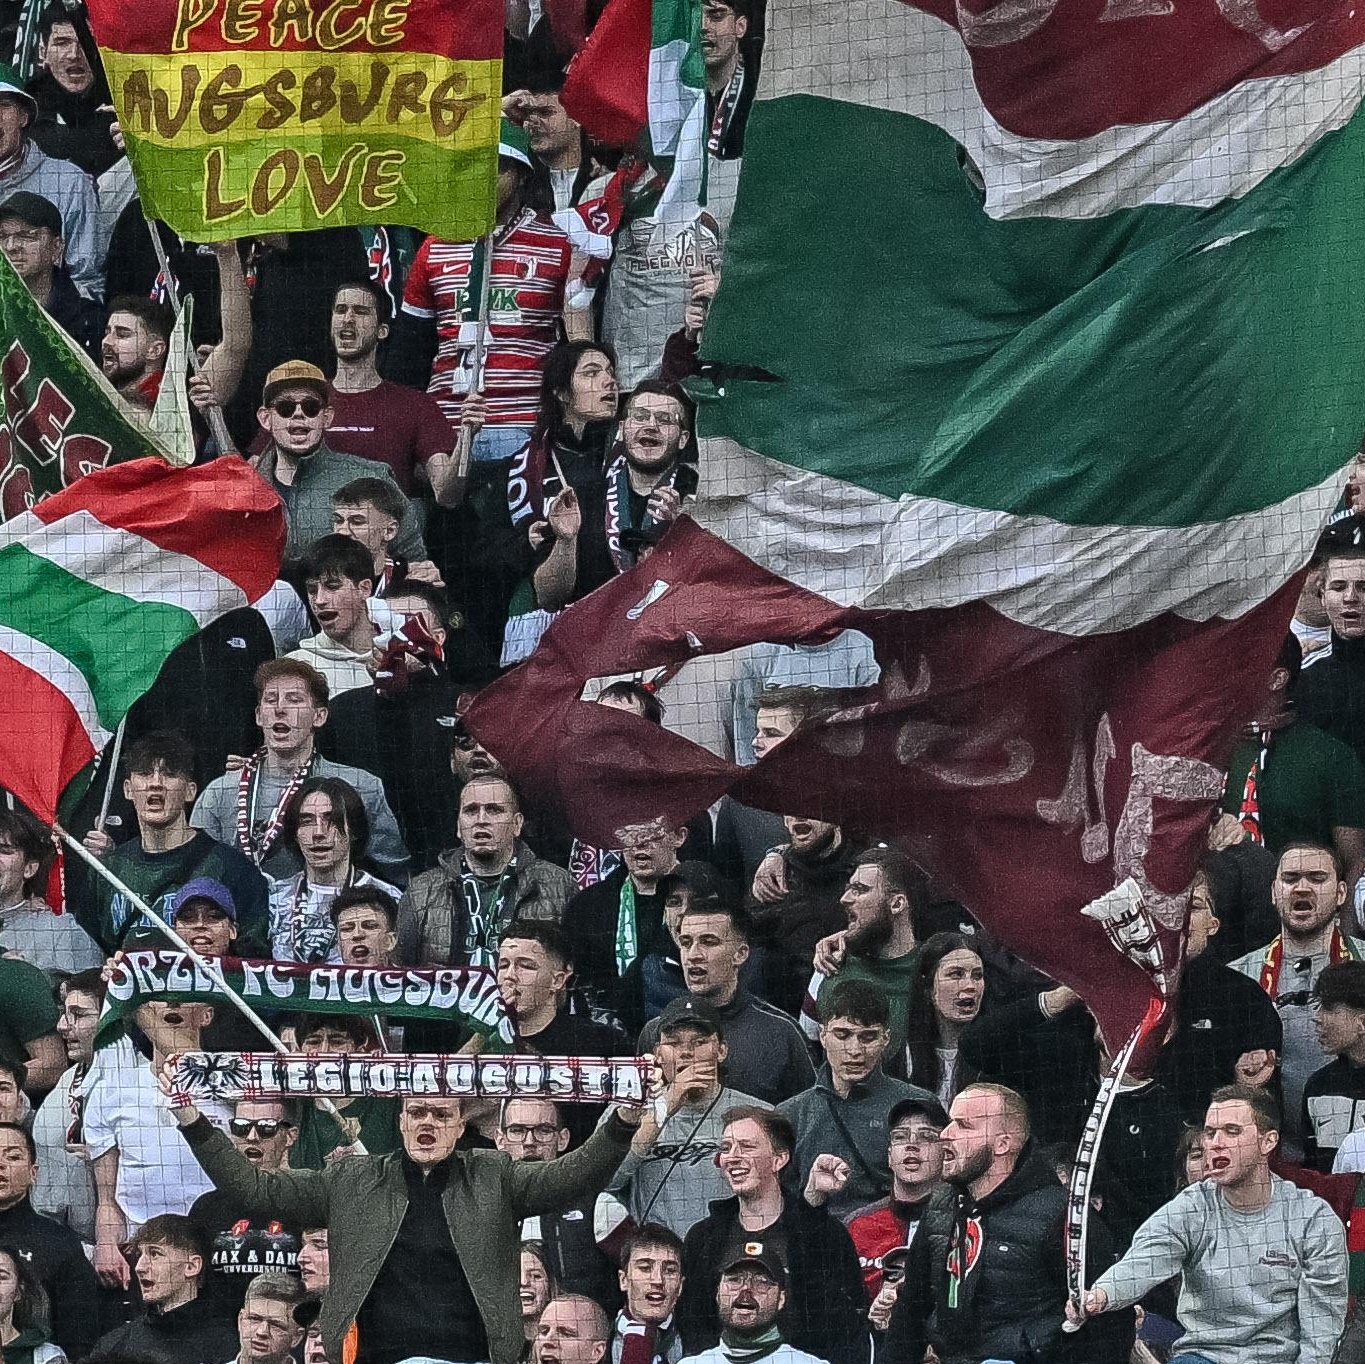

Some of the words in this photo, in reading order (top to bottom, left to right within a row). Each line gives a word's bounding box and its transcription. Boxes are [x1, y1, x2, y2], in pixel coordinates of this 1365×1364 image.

[173, 0, 412, 51] PEACE
[122, 62, 487, 140] AUGSBURG
[202, 142, 407, 223] LOVE
[108, 951, 224, 1000] ORZA
[241, 961, 296, 998] FC
[412, 1062, 644, 1100] AUGUSTA
